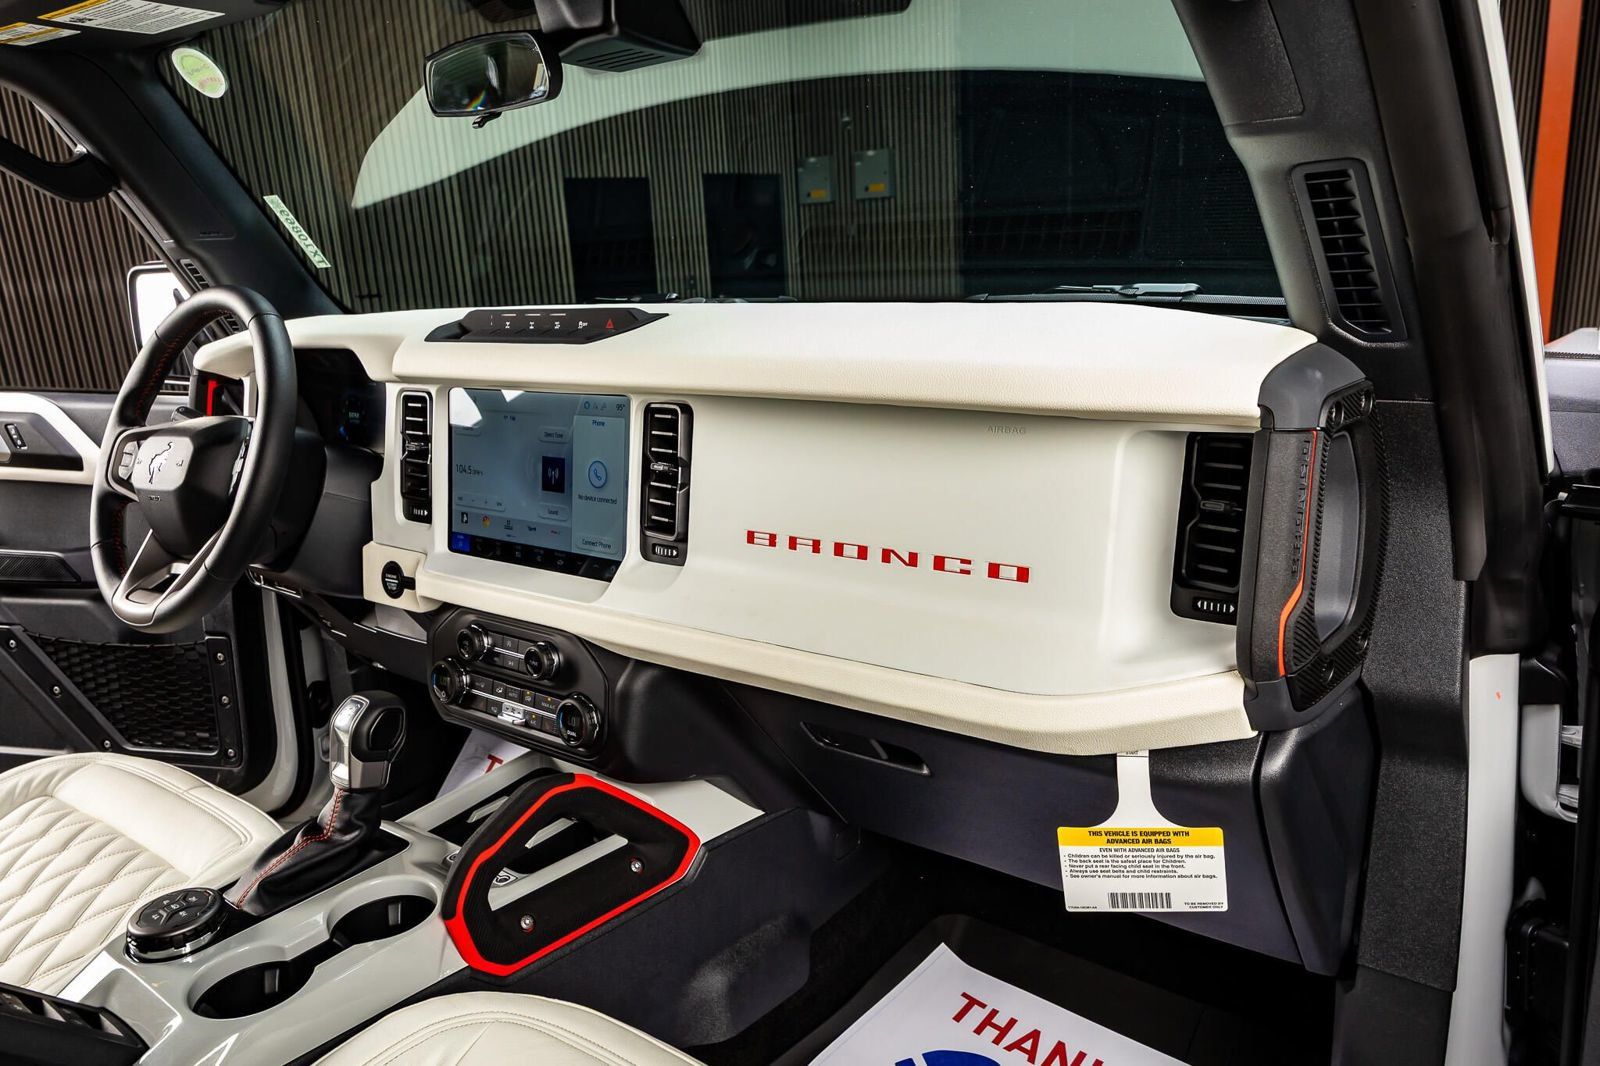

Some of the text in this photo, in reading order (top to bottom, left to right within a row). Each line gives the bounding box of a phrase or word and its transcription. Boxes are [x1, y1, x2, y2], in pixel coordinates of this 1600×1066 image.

[592, 419, 606, 427] Phone
[986, 425, 1026, 434] AIRBAG
[582, 538, 612, 549] Connect Phone
[746, 529, 1030, 583] BRONCO
[952, 992, 1104, 1066] THAN
